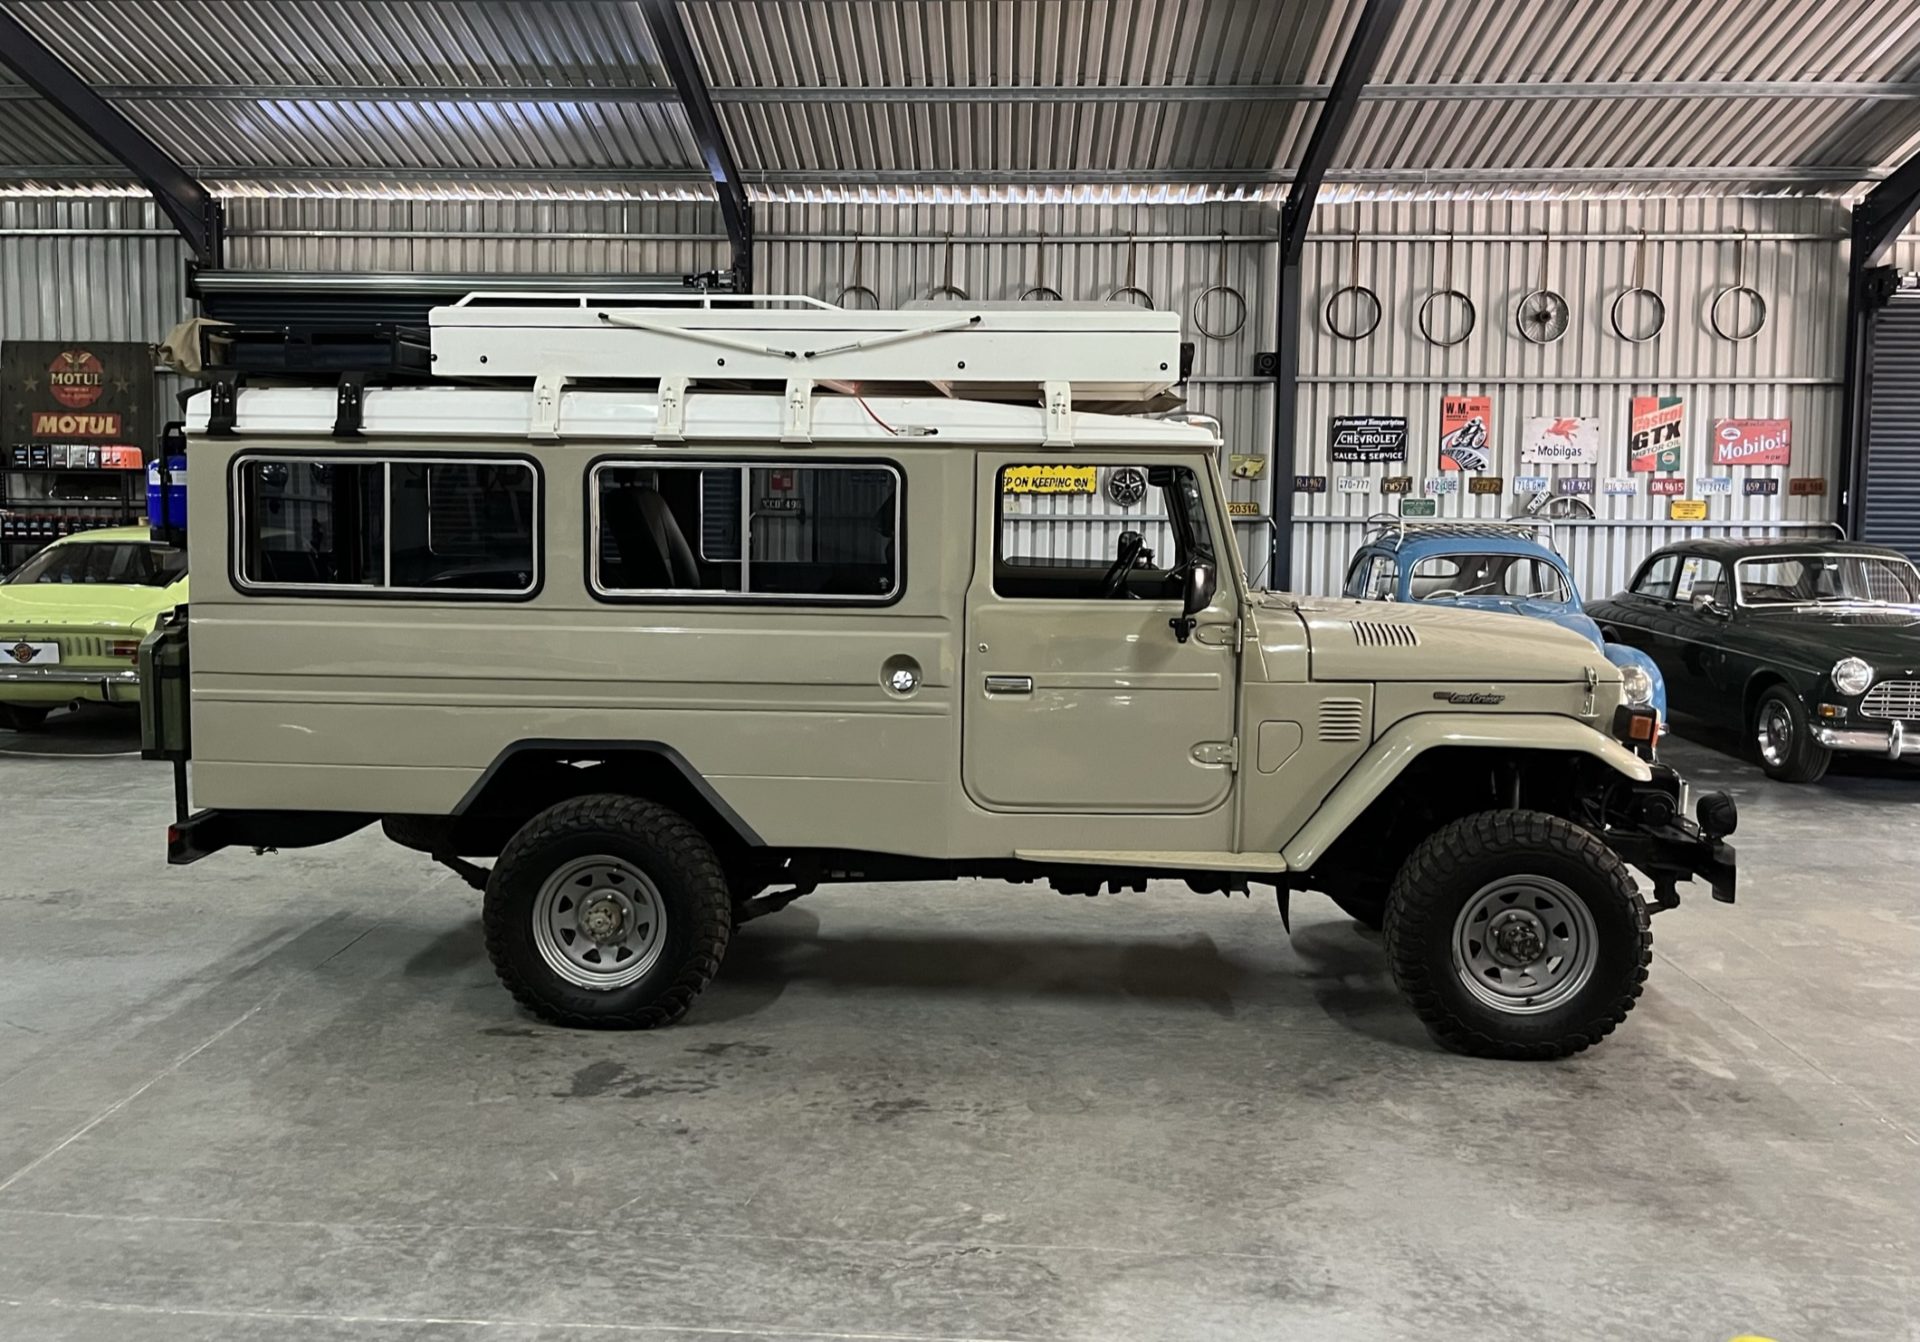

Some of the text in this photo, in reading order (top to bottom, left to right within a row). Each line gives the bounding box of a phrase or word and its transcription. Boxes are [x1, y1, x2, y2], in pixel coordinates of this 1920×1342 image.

[51, 373, 102, 385] MOTUL
[37, 415, 117, 434] MOTUL
[1633, 405, 1683, 432] Castrol
[1341, 434, 1397, 443] CHEVROLET
[1632, 420, 1681, 451] GTX
[1538, 445, 1582, 459] Mobilgas
[1632, 444, 1664, 459] MOTOR
[1667, 439, 1680, 448] OIL
[1334, 452, 1358, 460] SALES
[1369, 452, 1403, 460] SERVICE
[1014, 477, 1028, 487] ON
[1032, 477, 1071, 488] KEEPING
[1665, 482, 1683, 491] 9615
[1230, 505, 1257, 513] 20314
